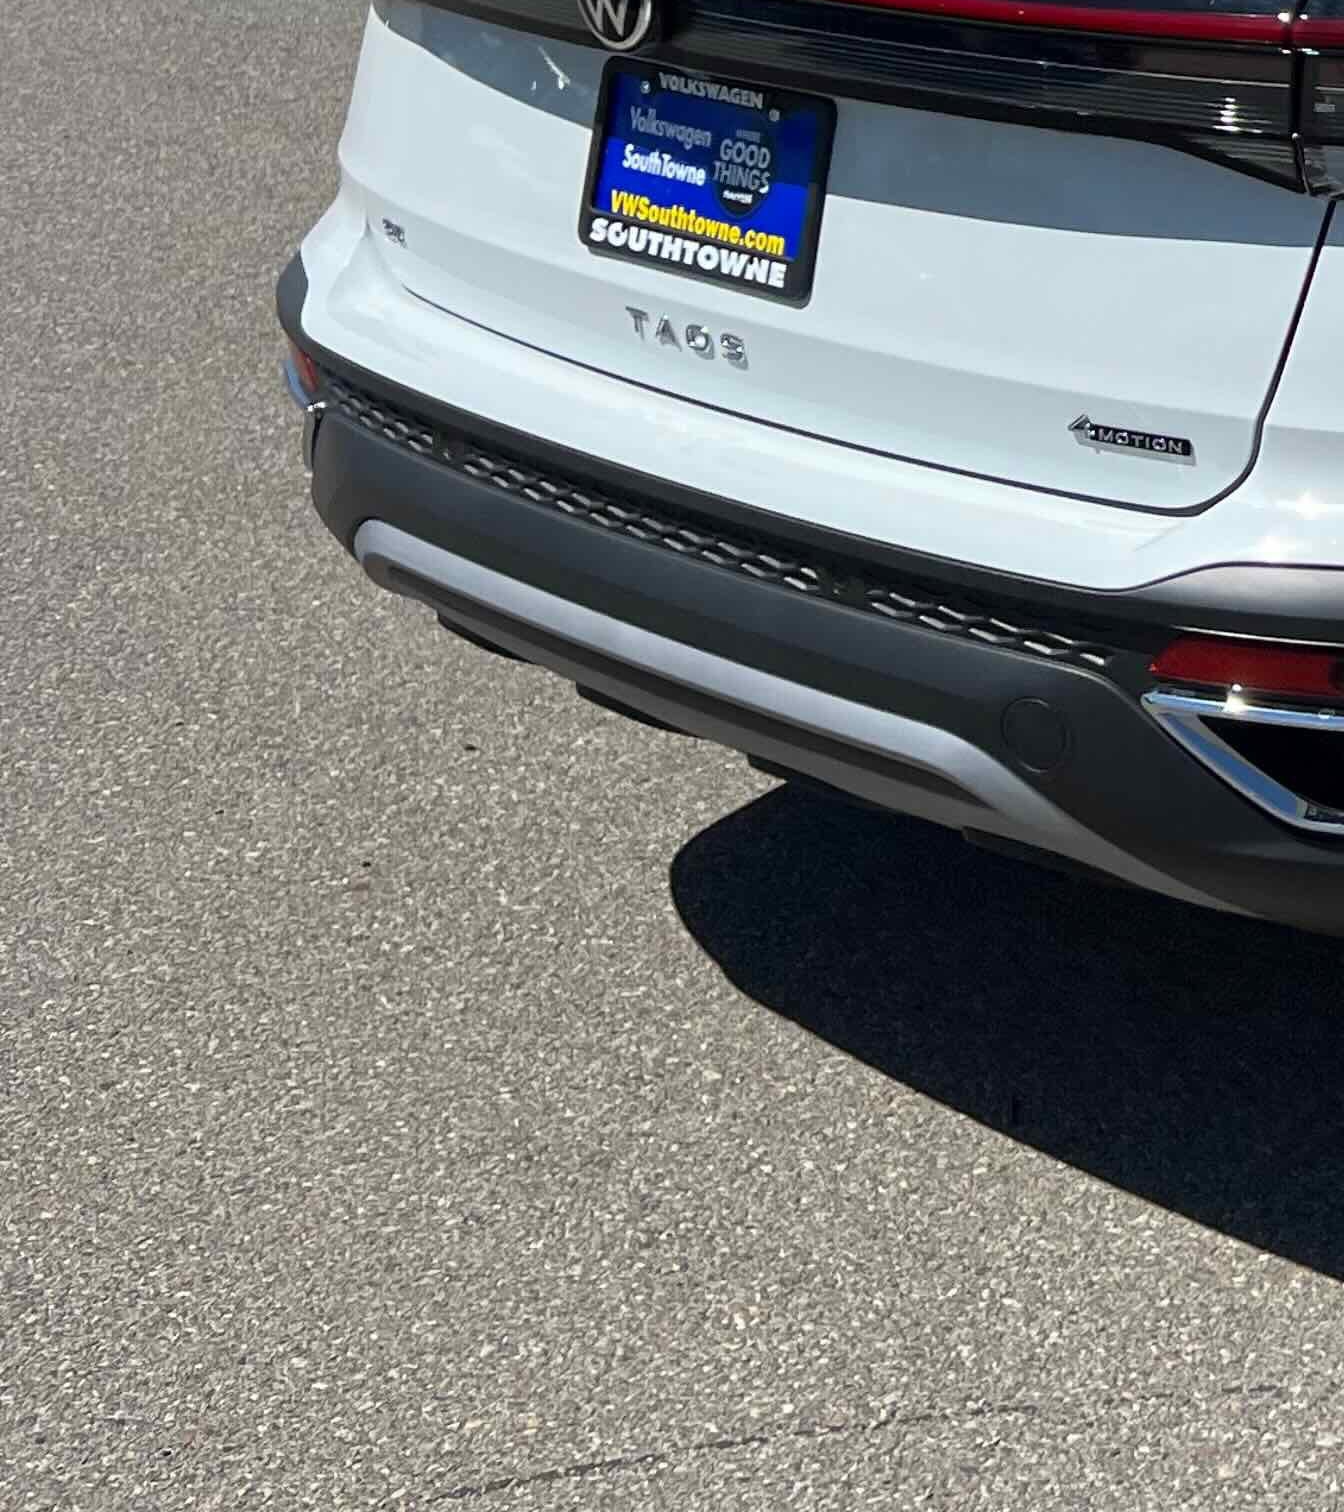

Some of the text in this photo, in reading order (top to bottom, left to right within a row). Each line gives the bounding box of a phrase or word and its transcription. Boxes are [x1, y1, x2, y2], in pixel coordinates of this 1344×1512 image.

[658, 72, 764, 109] VOLKSWAGEN
[630, 105, 712, 150] Volkswagen
[622, 143, 706, 186] SouthTowne
[720, 138, 771, 169] GOOD
[713, 160, 770, 194] THINGS
[611, 189, 785, 256] VWSouthtowne.com
[589, 218, 787, 288] SOUTHTOWNE
[625, 306, 747, 365] TAOS
